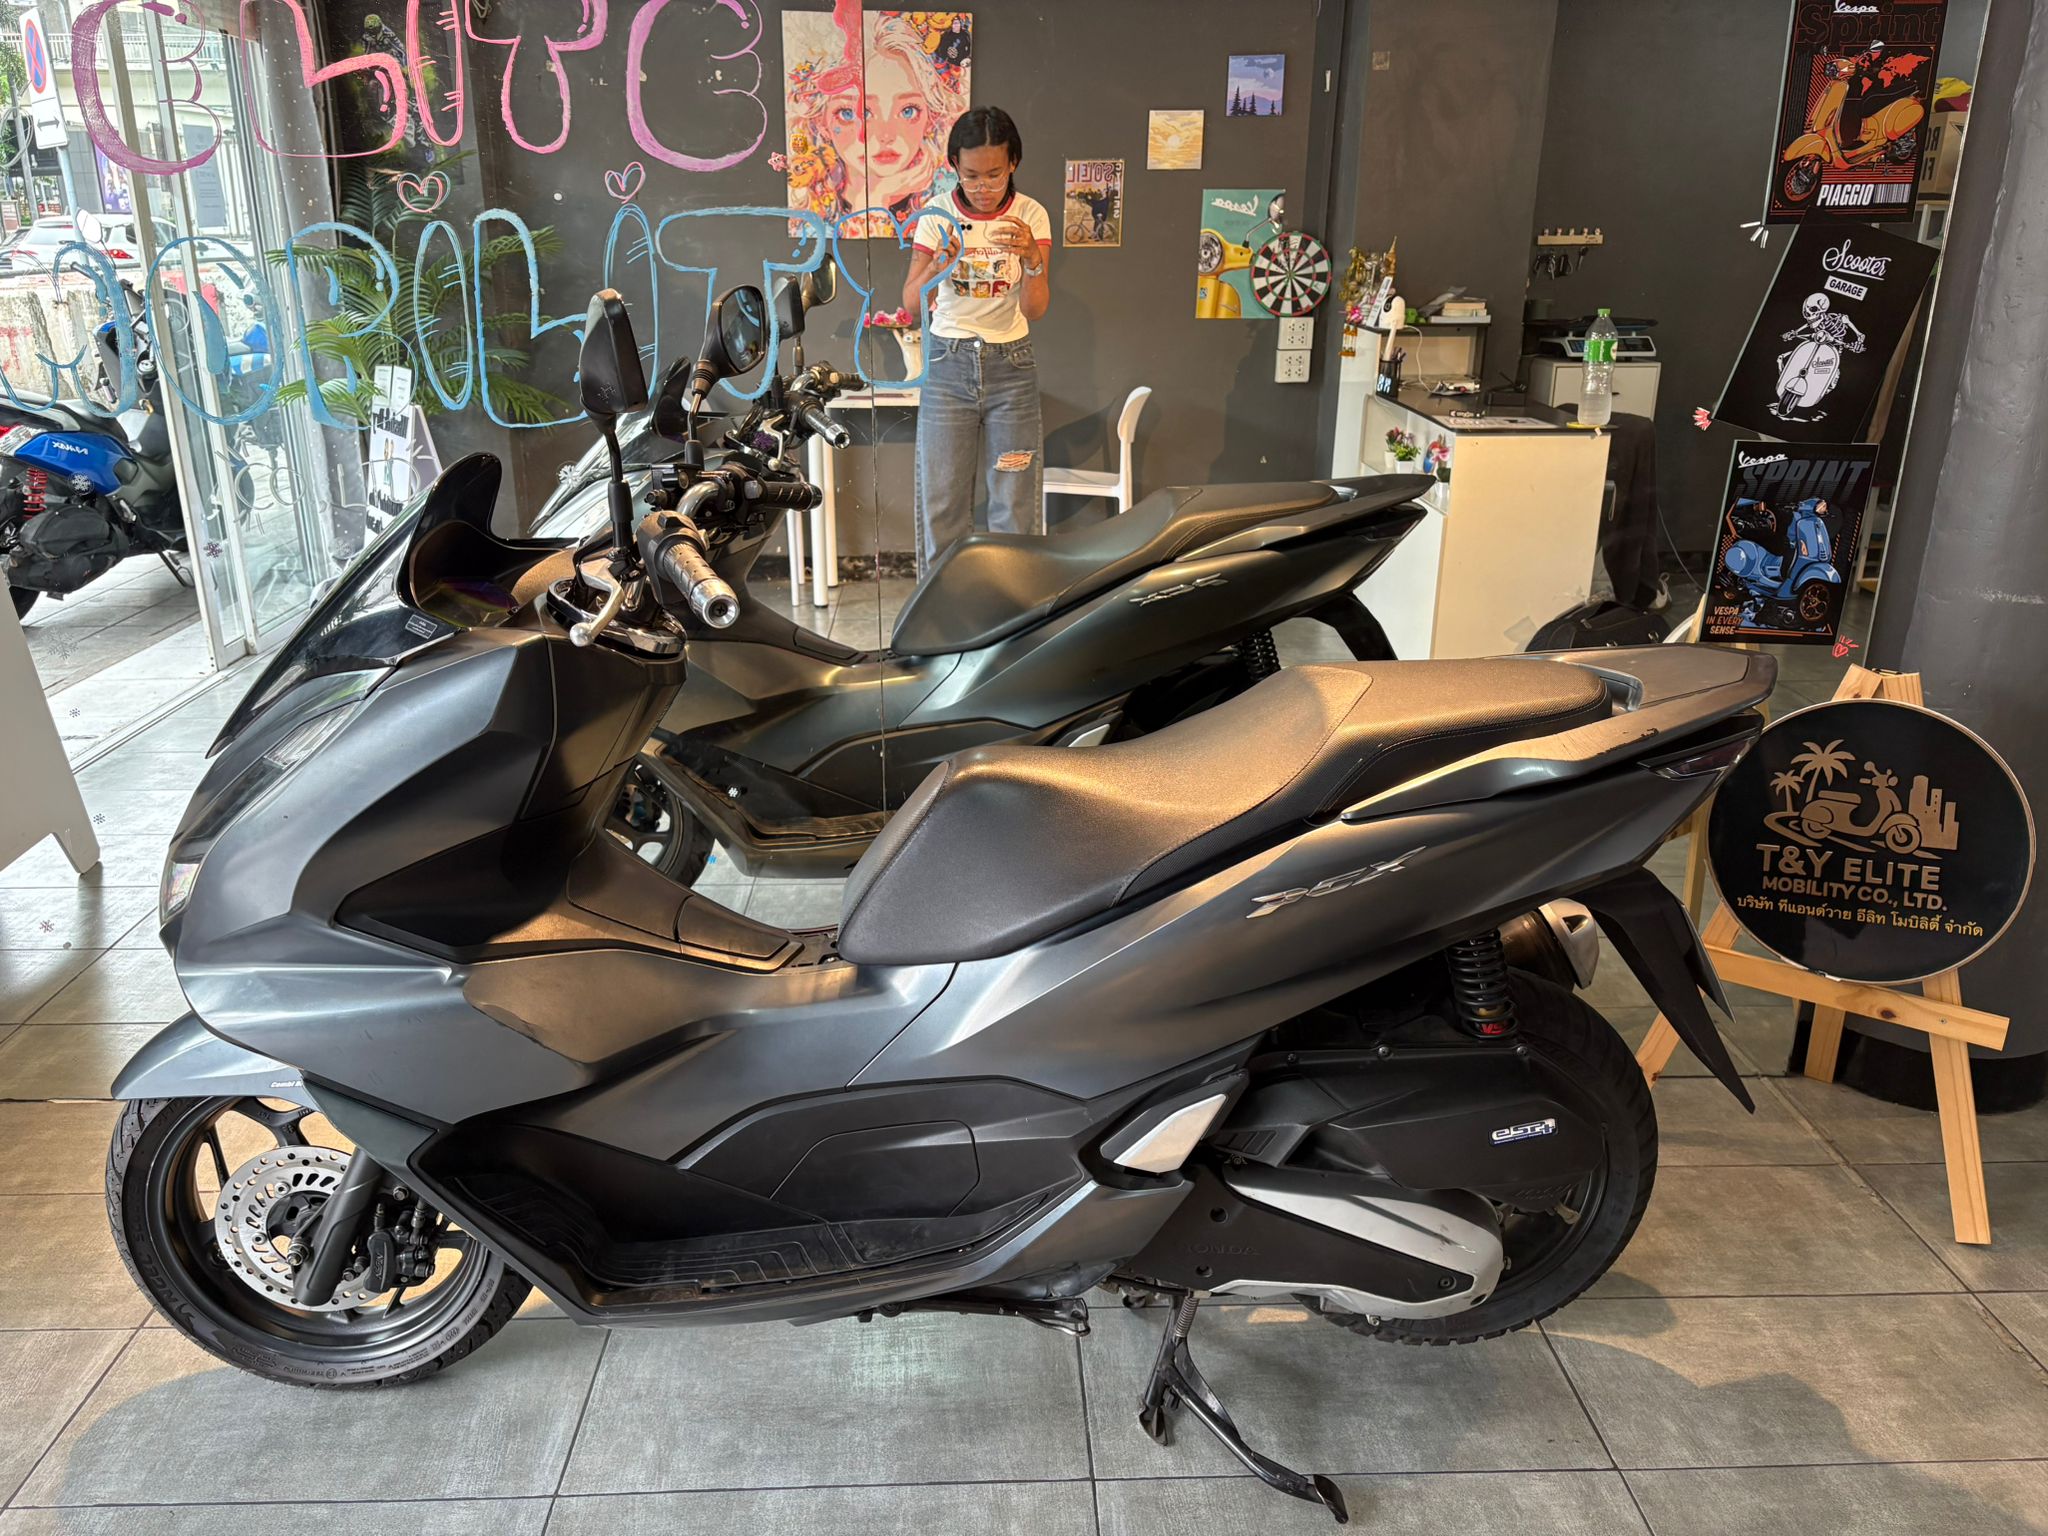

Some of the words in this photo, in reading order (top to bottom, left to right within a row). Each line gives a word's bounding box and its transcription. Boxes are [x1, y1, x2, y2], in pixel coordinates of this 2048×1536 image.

[1833, 0, 1879, 13] Vespa
[1797, 3, 1942, 46] Sprint
[1816, 184, 1875, 206] PIAGGIO
[1822, 239, 1892, 278] Scooter
[1829, 279, 1864, 297] GARAGE
[1738, 451, 1788, 468] Vespa
[1737, 461, 1871, 499] SPRINT
[1706, 616, 1716, 625] IN
[1717, 617, 1744, 625] EVERY
[1714, 606, 1740, 615] VESPA
[1710, 626, 1736, 635] SENSE
[1756, 843, 1833, 878] T&Y
[1843, 857, 1941, 891] ELITE
[1762, 876, 1856, 900] MOBILITY
[1857, 885, 1898, 908] CO.,
[1903, 891, 1948, 912] LTD.
[1737, 895, 1774, 911] บริษัท
[1944, 919, 1984, 937] จำกัด
